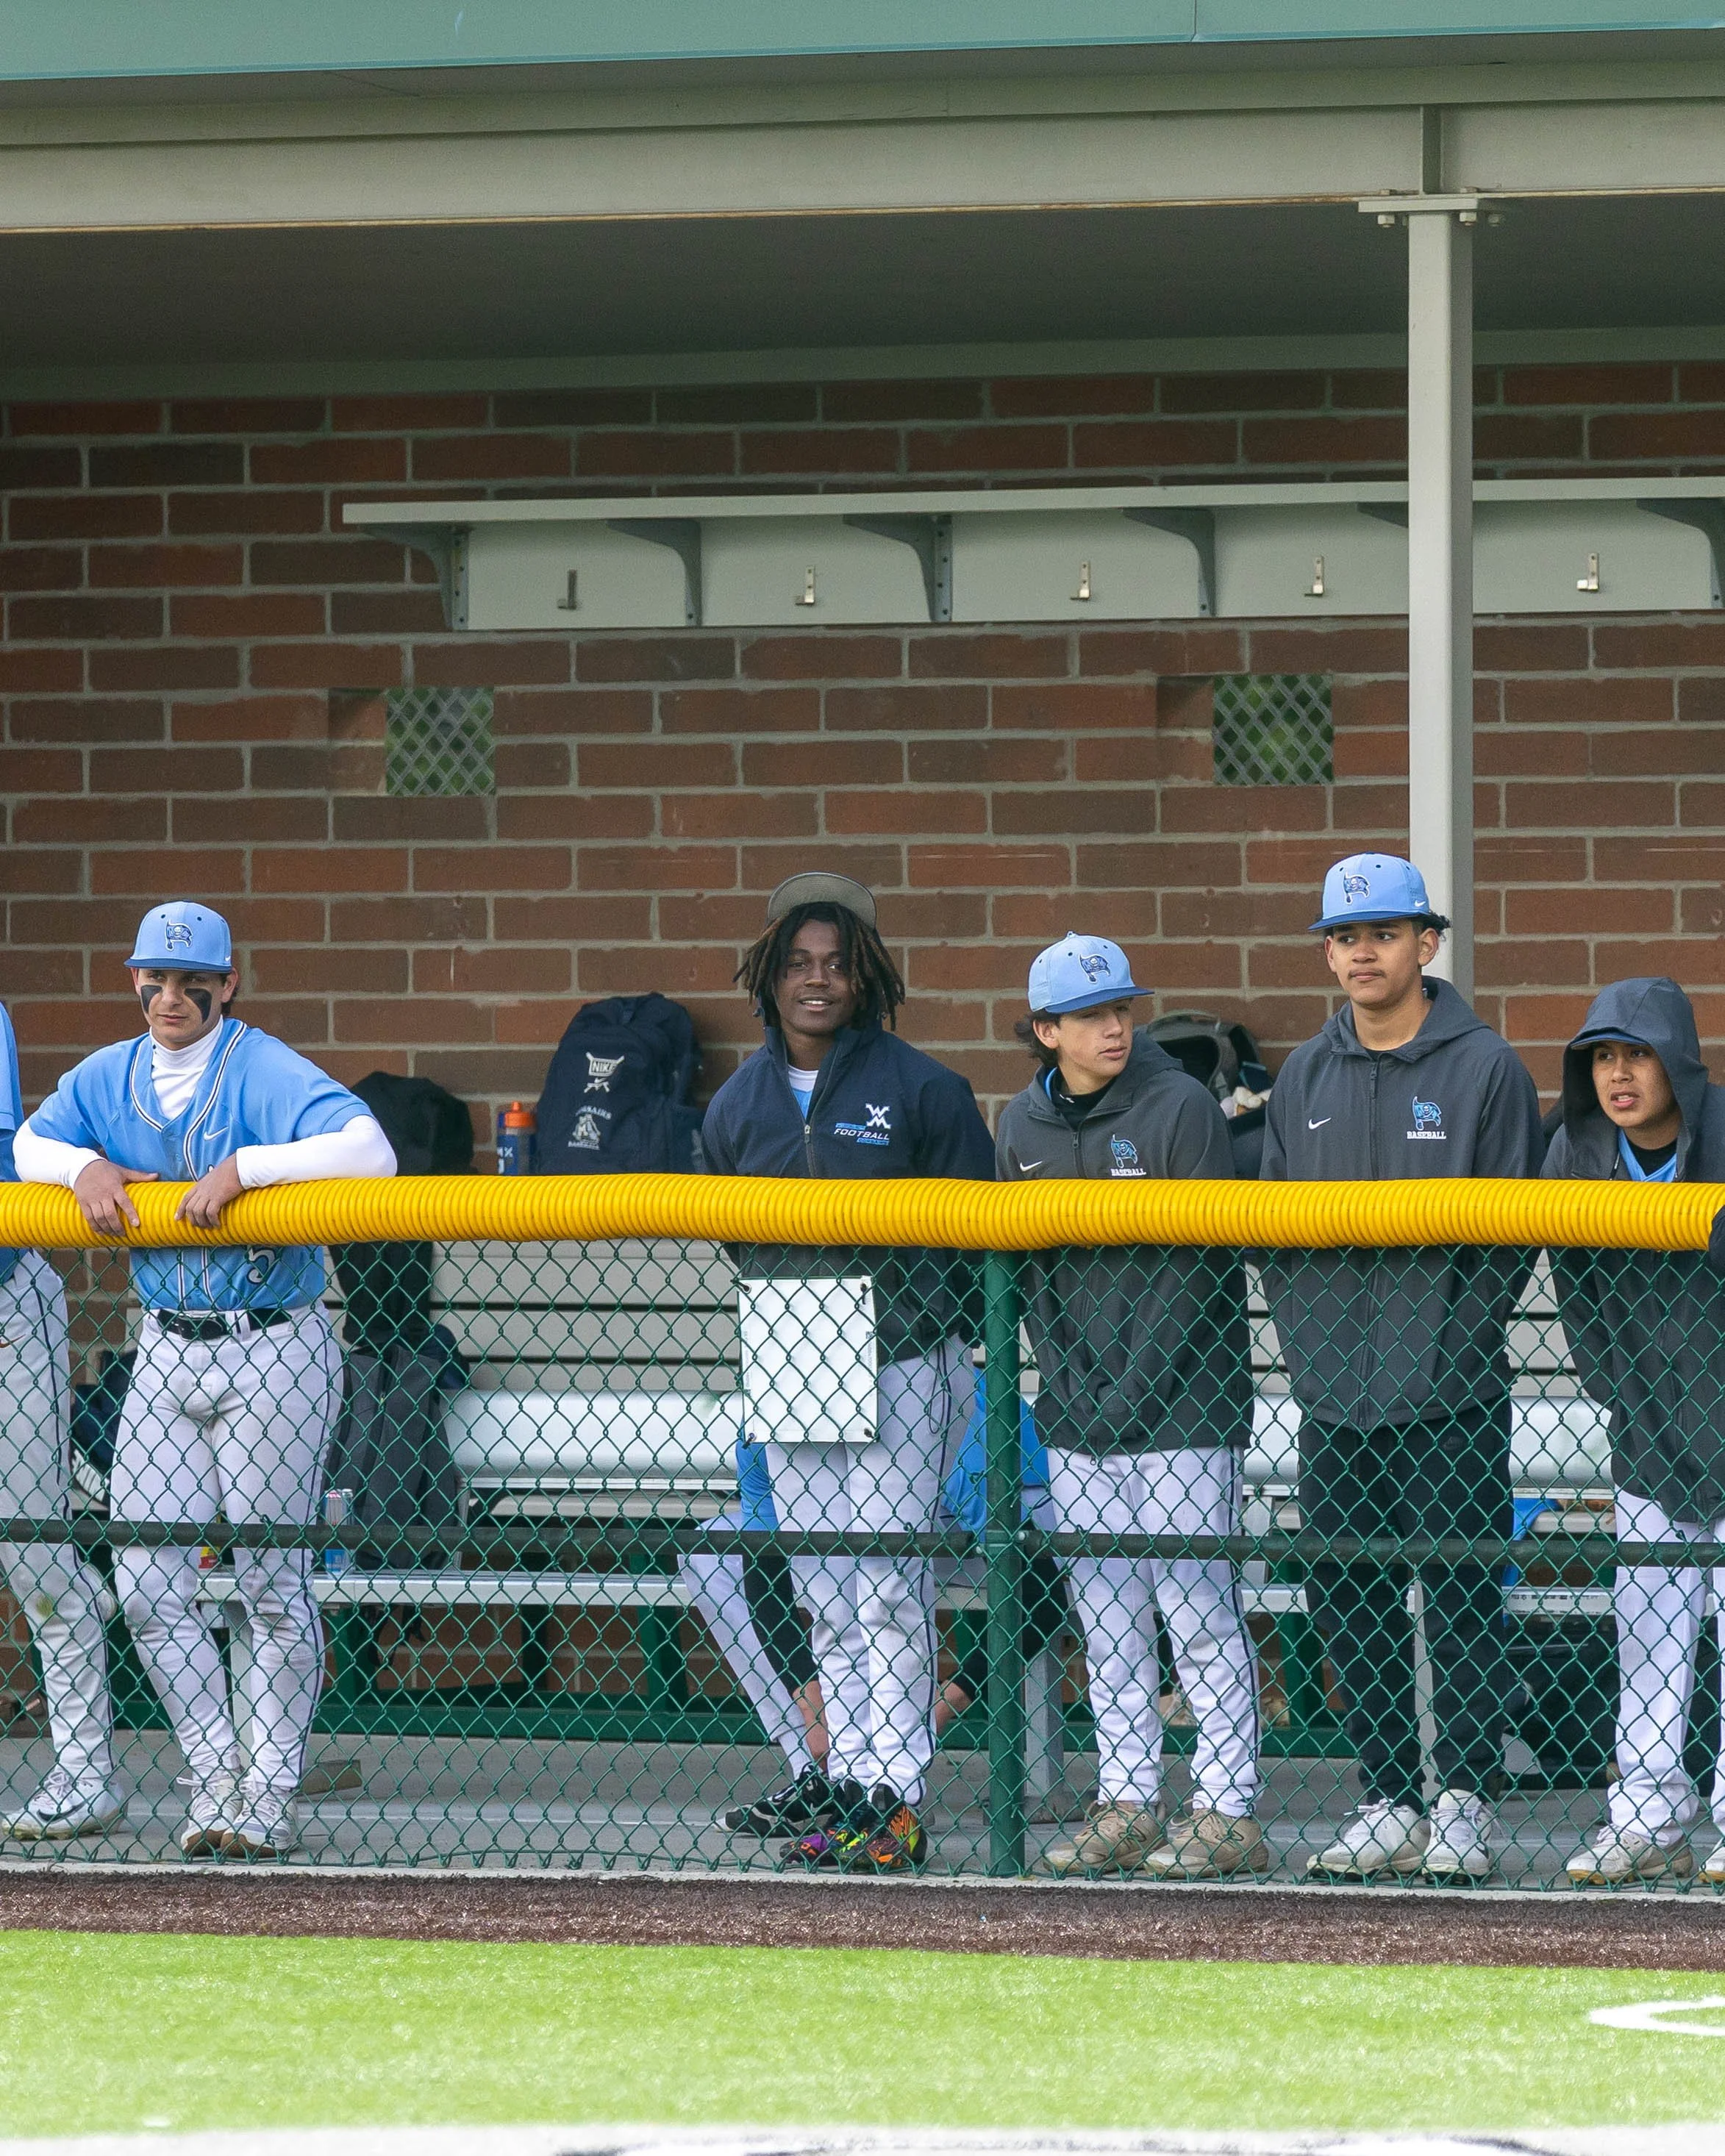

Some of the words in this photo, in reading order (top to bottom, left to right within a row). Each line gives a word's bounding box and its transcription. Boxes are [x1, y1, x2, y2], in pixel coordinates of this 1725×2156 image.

[592, 1060, 617, 1074] NIKE
[834, 1128, 890, 1140] FOOTBALL
[1407, 1131, 1447, 1139] BASEBALL
[1110, 1168, 1146, 1177] BASEBALL
